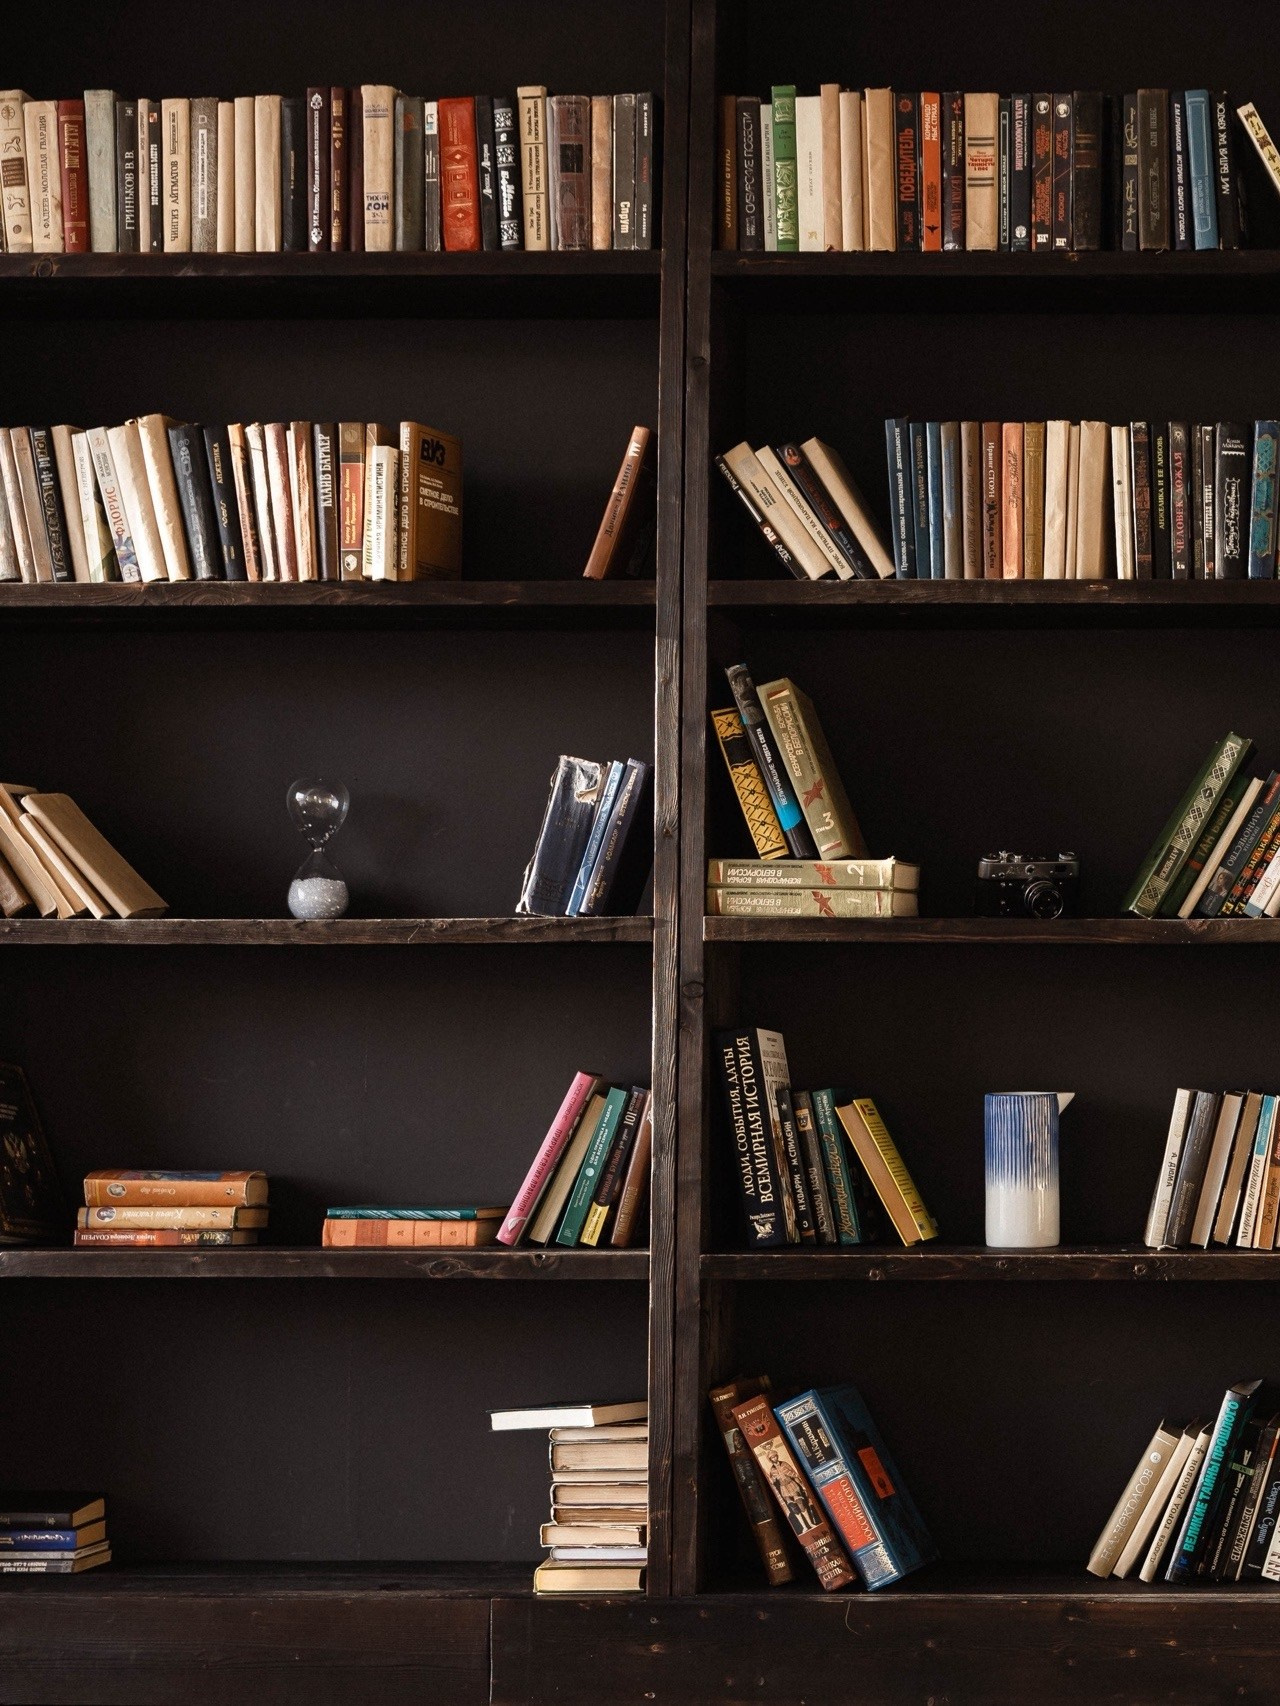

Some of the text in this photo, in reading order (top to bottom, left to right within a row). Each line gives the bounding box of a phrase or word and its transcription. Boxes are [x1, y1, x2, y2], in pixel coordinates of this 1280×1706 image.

[39, 115, 47, 150] ГВАРДИЯ
[743, 112, 754, 157] ПОВЕСТИ
[1217, 102, 1230, 195] МИГ БЫТИЯ ТАК КРАТОК
[40, 153, 48, 193] МОЛОДАЯ
[169, 161, 178, 204] АЙТМАТОВ
[899, 128, 916, 201] ПОБЕДИТЕЛЬ
[125, 150, 135, 230] ГРИНЬКОВ В. В.
[619, 201, 630, 233] Спрут
[213, 442, 223, 484] АНЖЕЛИКА
[318, 433, 333, 507] КЛАЙВ БАРКЕР
[401, 427, 410, 493] СТРОИТЕЛЬСТВЕ
[894, 428, 903, 469] деятельности
[896, 472, 905, 514] нотариальной
[1158, 469, 1164, 478] ЕЕ
[105, 486, 125, 537] ФЛОРИС
[401, 505, 409, 528] ДЕЛО
[720, 463, 792, 563] ЭДГАР ПО Рассказы
[775, 470, 845, 570] БОРИС ПУТИЛОВ НА ПАРОХОДНОЙ УЛИЦЕ
[1174, 452, 1185, 553] ЧЕЛОВЕК ДОЖДЯ
[401, 532, 409, 569] СМЕТНОЕ
[773, 704, 803, 778] ВСЕНАРОДНАЯ БОРЬБА
[780, 701, 799, 746] БЕЛОРУССИИ
[756, 727, 788, 806] ВЕЛИЧАЙШИЕ ЧУДЕСА СВЕТА
[1226, 806, 1264, 867] ОДИНОЧЕСТВО
[726, 876, 802, 884] ВСЕНАРОДНАЯ БОРЬБА
[727, 868, 782, 877] В БЕЛОРУССИИ
[847, 863, 865, 875] 2
[726, 897, 774, 905] БЕЛОРУССИИ
[623, 1111, 637, 1125] 101
[723, 1048, 756, 1196] ЛЮДИ, СОБЫТИЯ, ДАТЫ
[736, 1036, 774, 1203] ВСЕМИРНАЯ ИСТОРИЯ
[607, 1149, 623, 1172] БУЛЬОН
[1166, 1160, 1174, 1187] ДЮМА
[1182, 1400, 1240, 1552] ВЕЛИКИЕ ТАЙНЫ ПРОШЛОГО
[840, 1479, 876, 1542] РОССИЙСКОГО
[823, 1567, 844, 1582] СТЕПЬ
